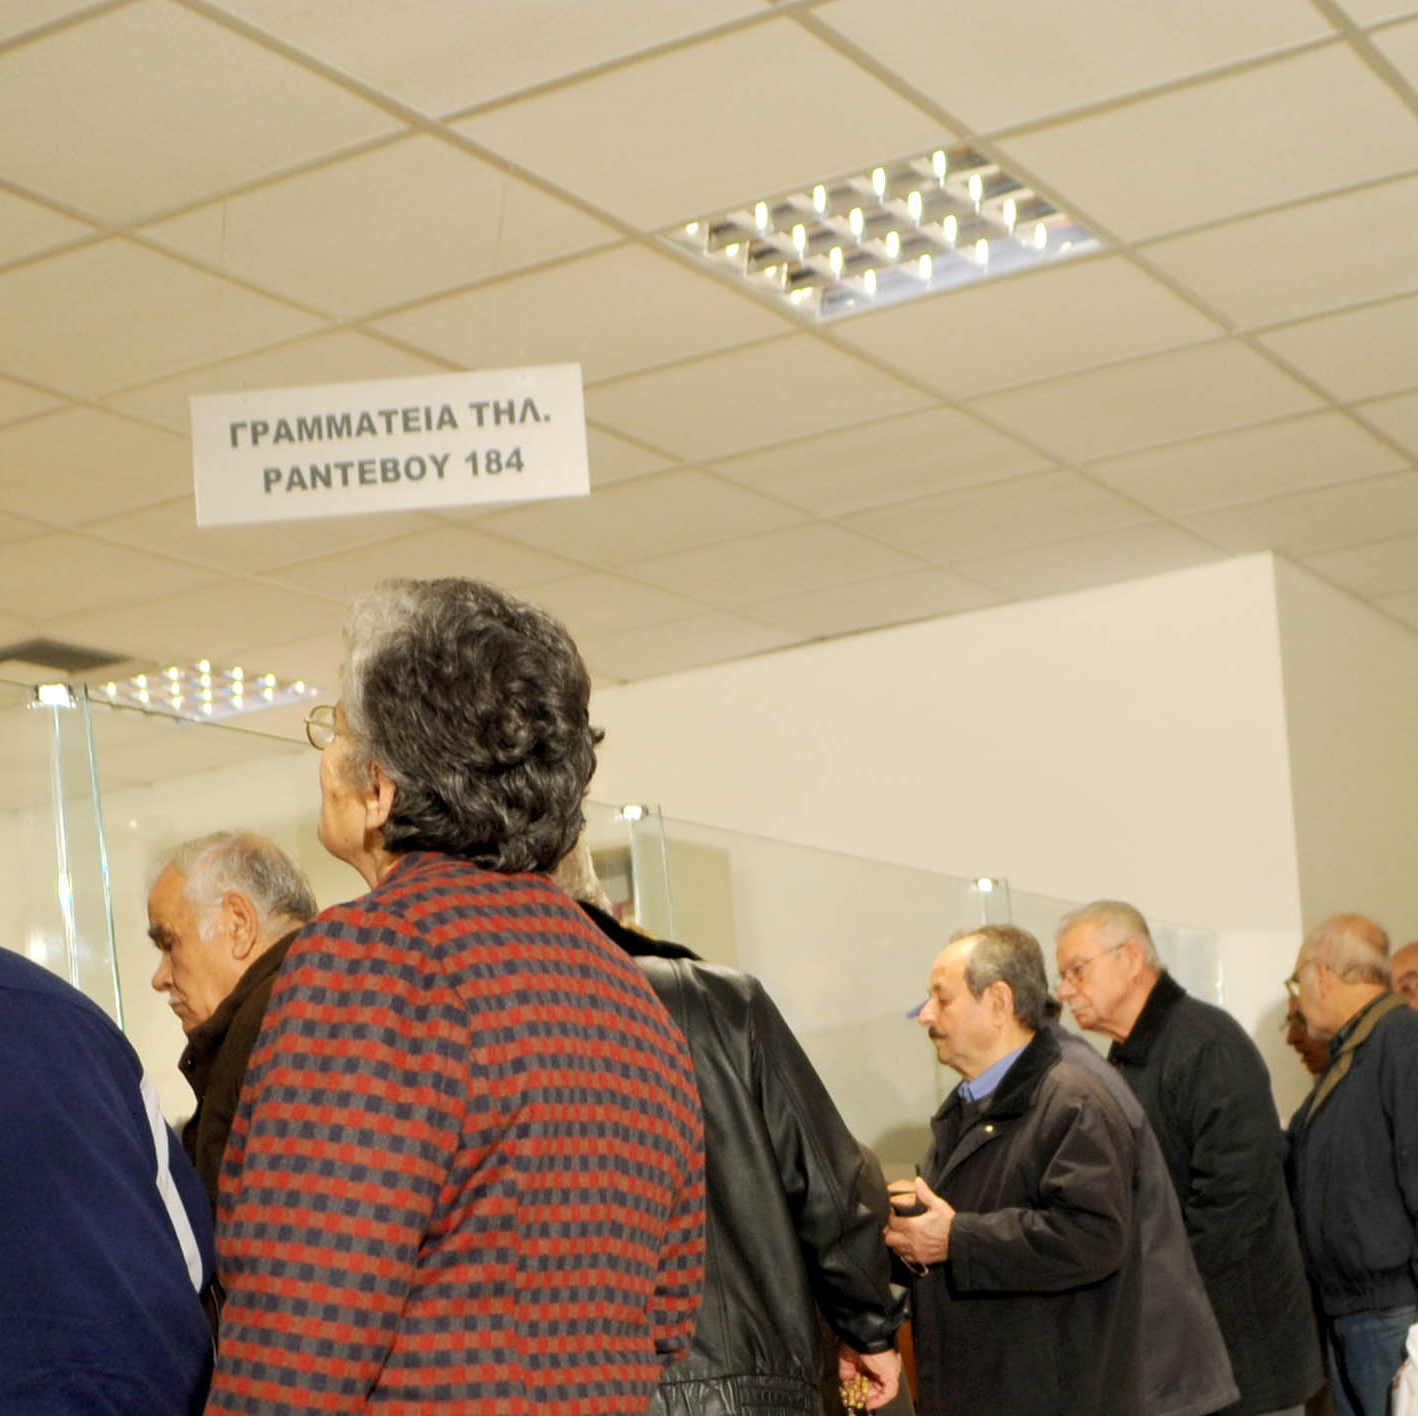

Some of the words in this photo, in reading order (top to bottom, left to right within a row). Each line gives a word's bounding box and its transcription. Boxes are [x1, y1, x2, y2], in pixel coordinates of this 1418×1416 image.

[229, 404, 458, 449] ΓΡΑΜΜΑΤΕΙΑ
[469, 397, 552, 428] ΤΗΛ.
[263, 453, 451, 494] ΡΑΝΤΕΒΟΥ
[464, 447, 525, 477] 184
